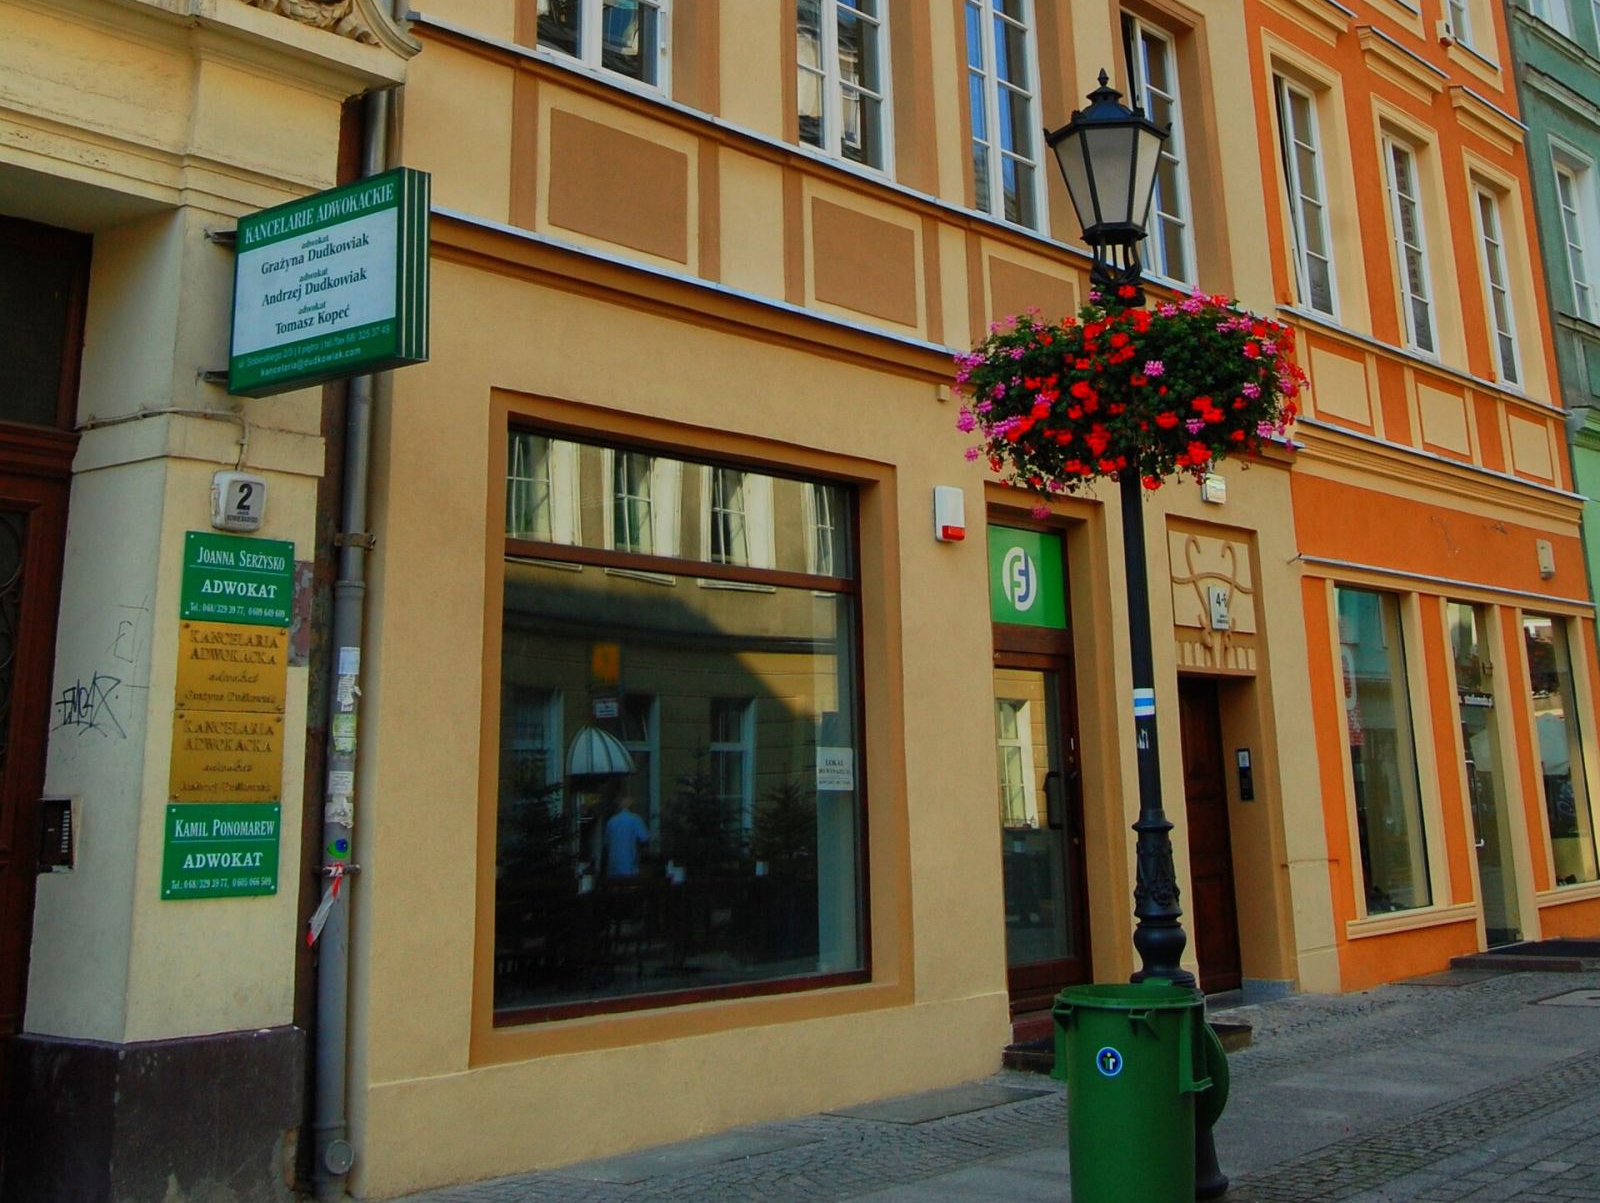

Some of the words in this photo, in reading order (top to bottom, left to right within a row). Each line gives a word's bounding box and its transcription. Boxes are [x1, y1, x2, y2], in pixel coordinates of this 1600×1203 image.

[245, 208, 314, 244] KANCELARIE
[316, 183, 394, 223] ADWOKACKIE
[301, 235, 329, 249] adwokat
[261, 254, 304, 275] Grażyna
[307, 233, 369, 262] Dudkowiak
[299, 268, 328, 283] adwokat
[262, 284, 302, 307] Andrzej
[305, 267, 367, 295] Dudkowiak
[275, 316, 315, 335] Tomasz
[317, 304, 350, 325] Kopeć
[237, 483, 253, 511] 2
[197, 547, 235, 566] JOANNA
[239, 549, 285, 571] SERŻYSKO
[201, 579, 278, 599] ADWOKAT
[190, 629, 279, 649] KANCELARIA
[190, 648, 277, 665] ADWOKACKA
[184, 720, 274, 736] KANCELARIA
[184, 737, 273, 753] ADWOKACKA
[175, 819, 208, 837] KAMIL
[213, 819, 275, 836] PONOMAREW
[182, 852, 263, 869] ADWOKAT
